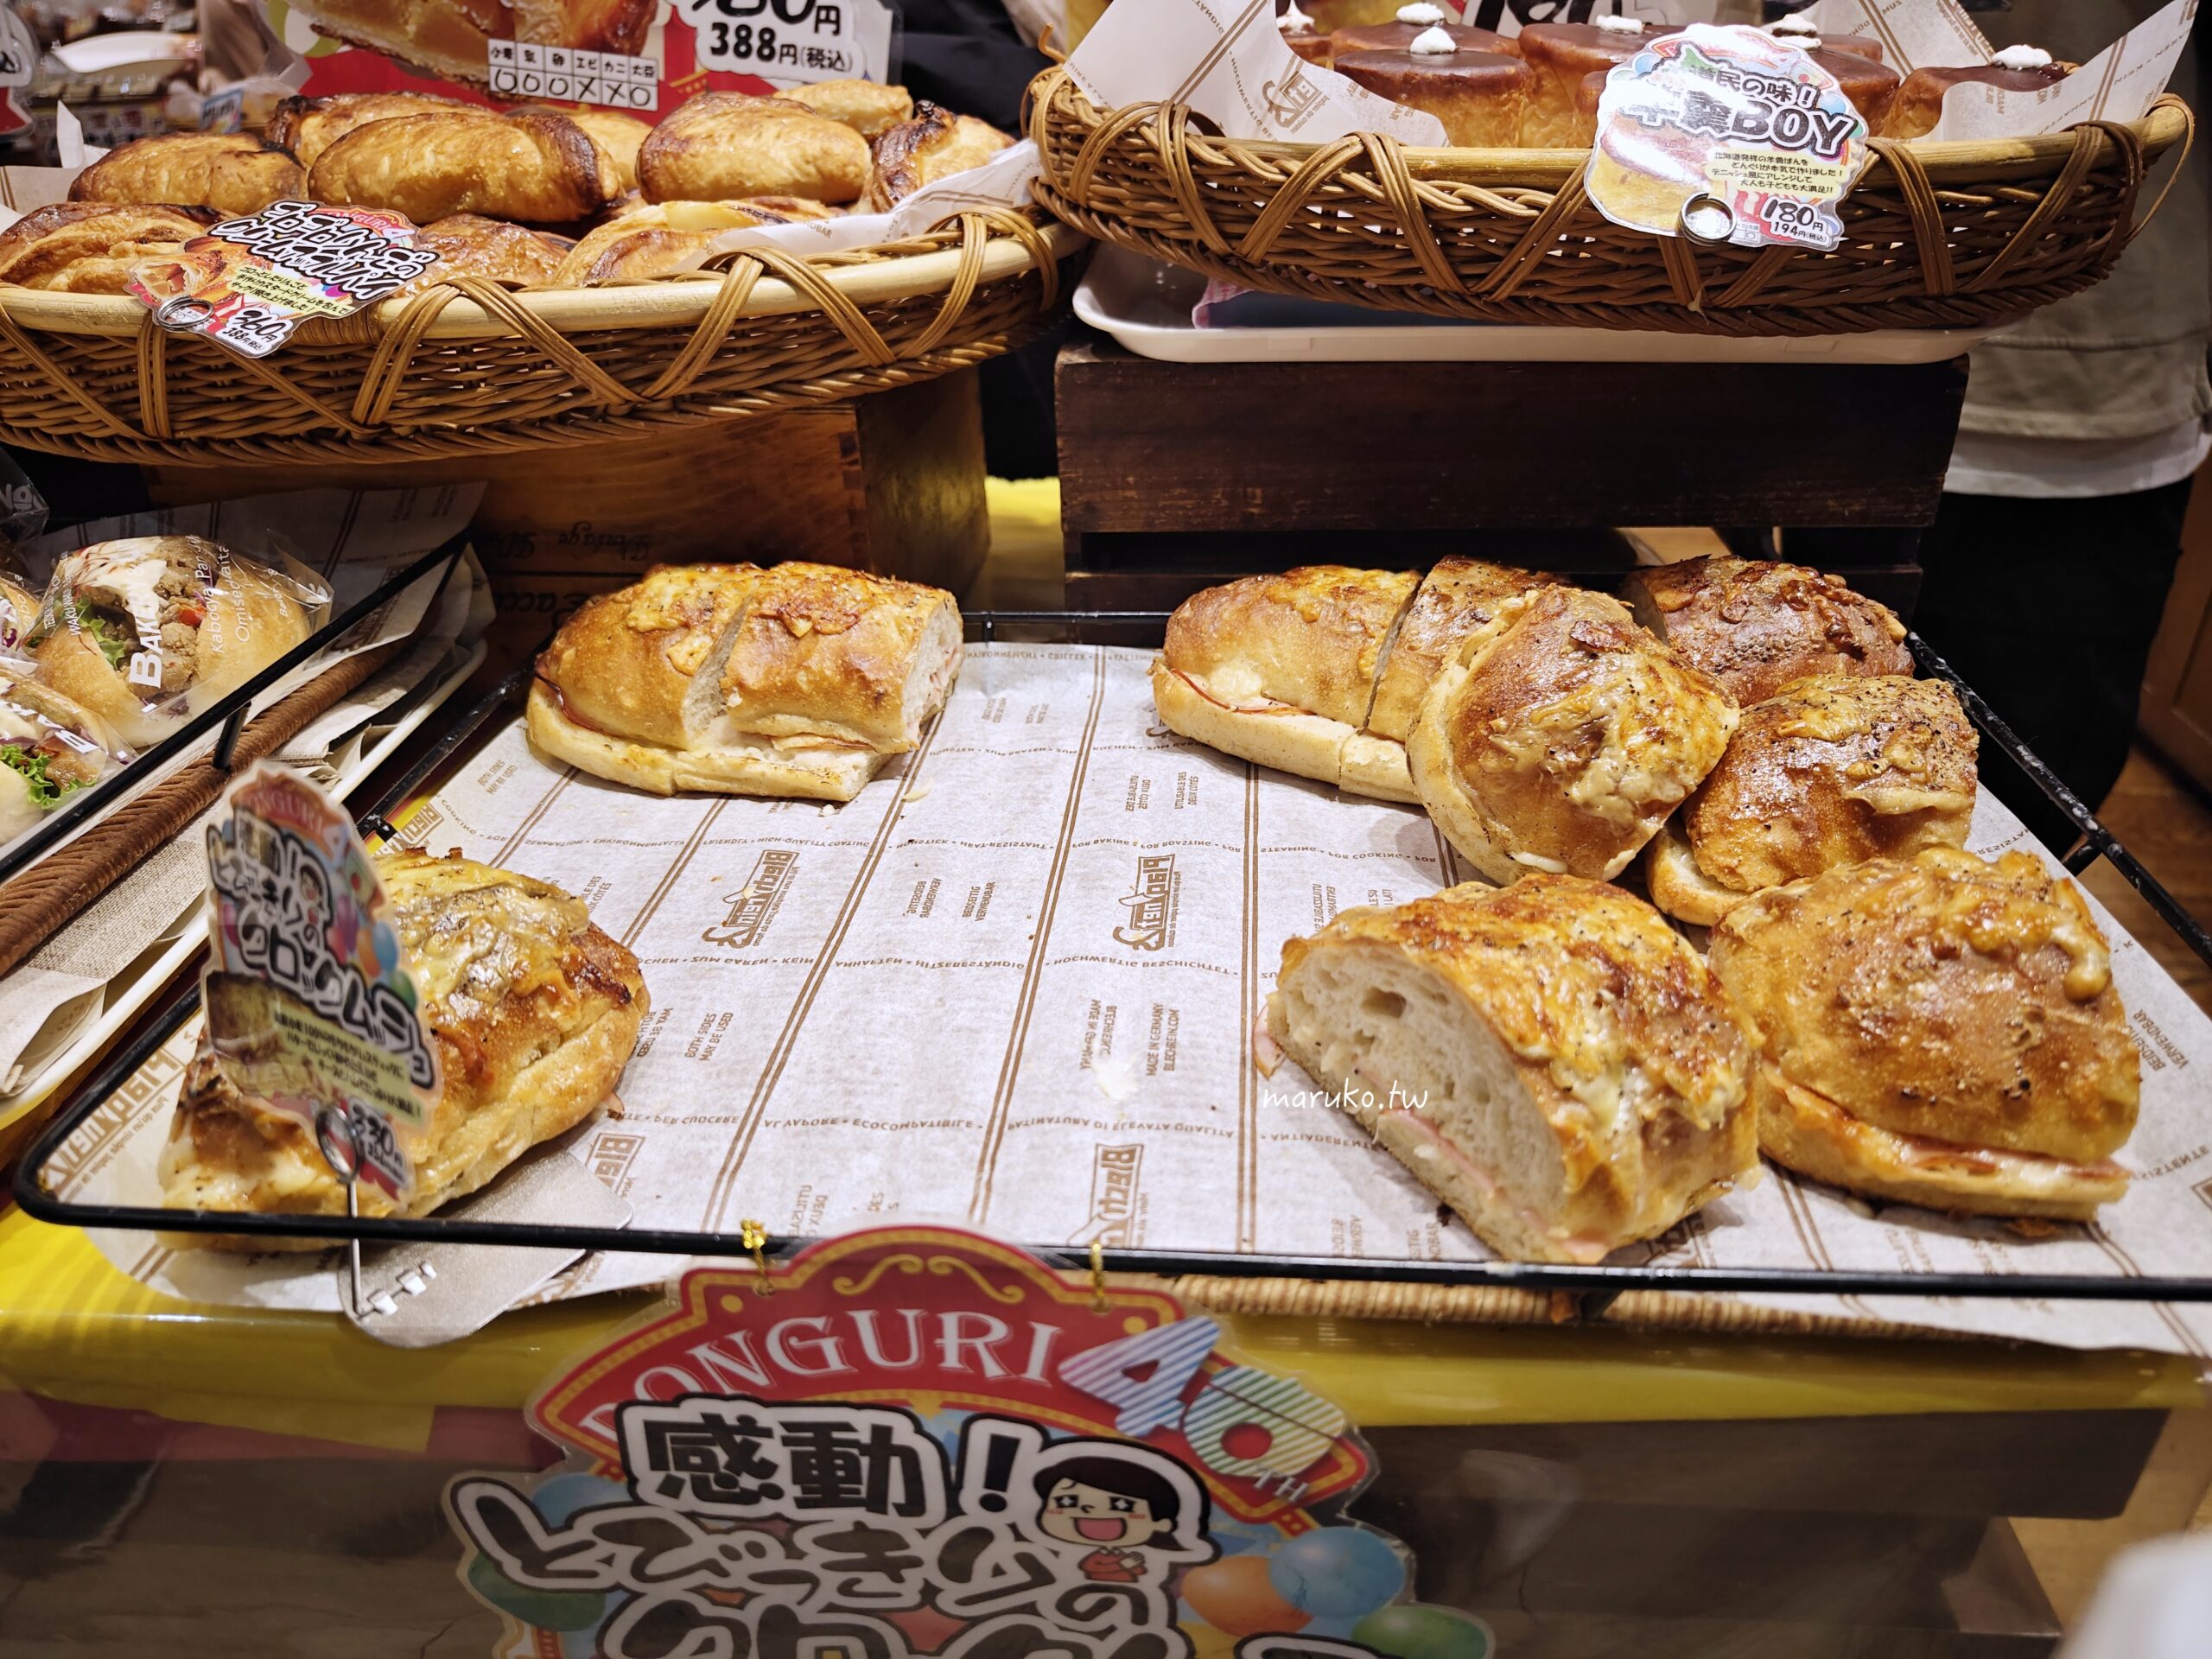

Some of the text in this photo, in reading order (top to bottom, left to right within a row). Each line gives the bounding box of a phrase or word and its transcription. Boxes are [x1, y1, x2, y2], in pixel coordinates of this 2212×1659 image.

[709, 22, 853, 73] 388円(税込)
[1765, 199, 1823, 232] 180円
[643, 1412, 1021, 1516] 感動!
